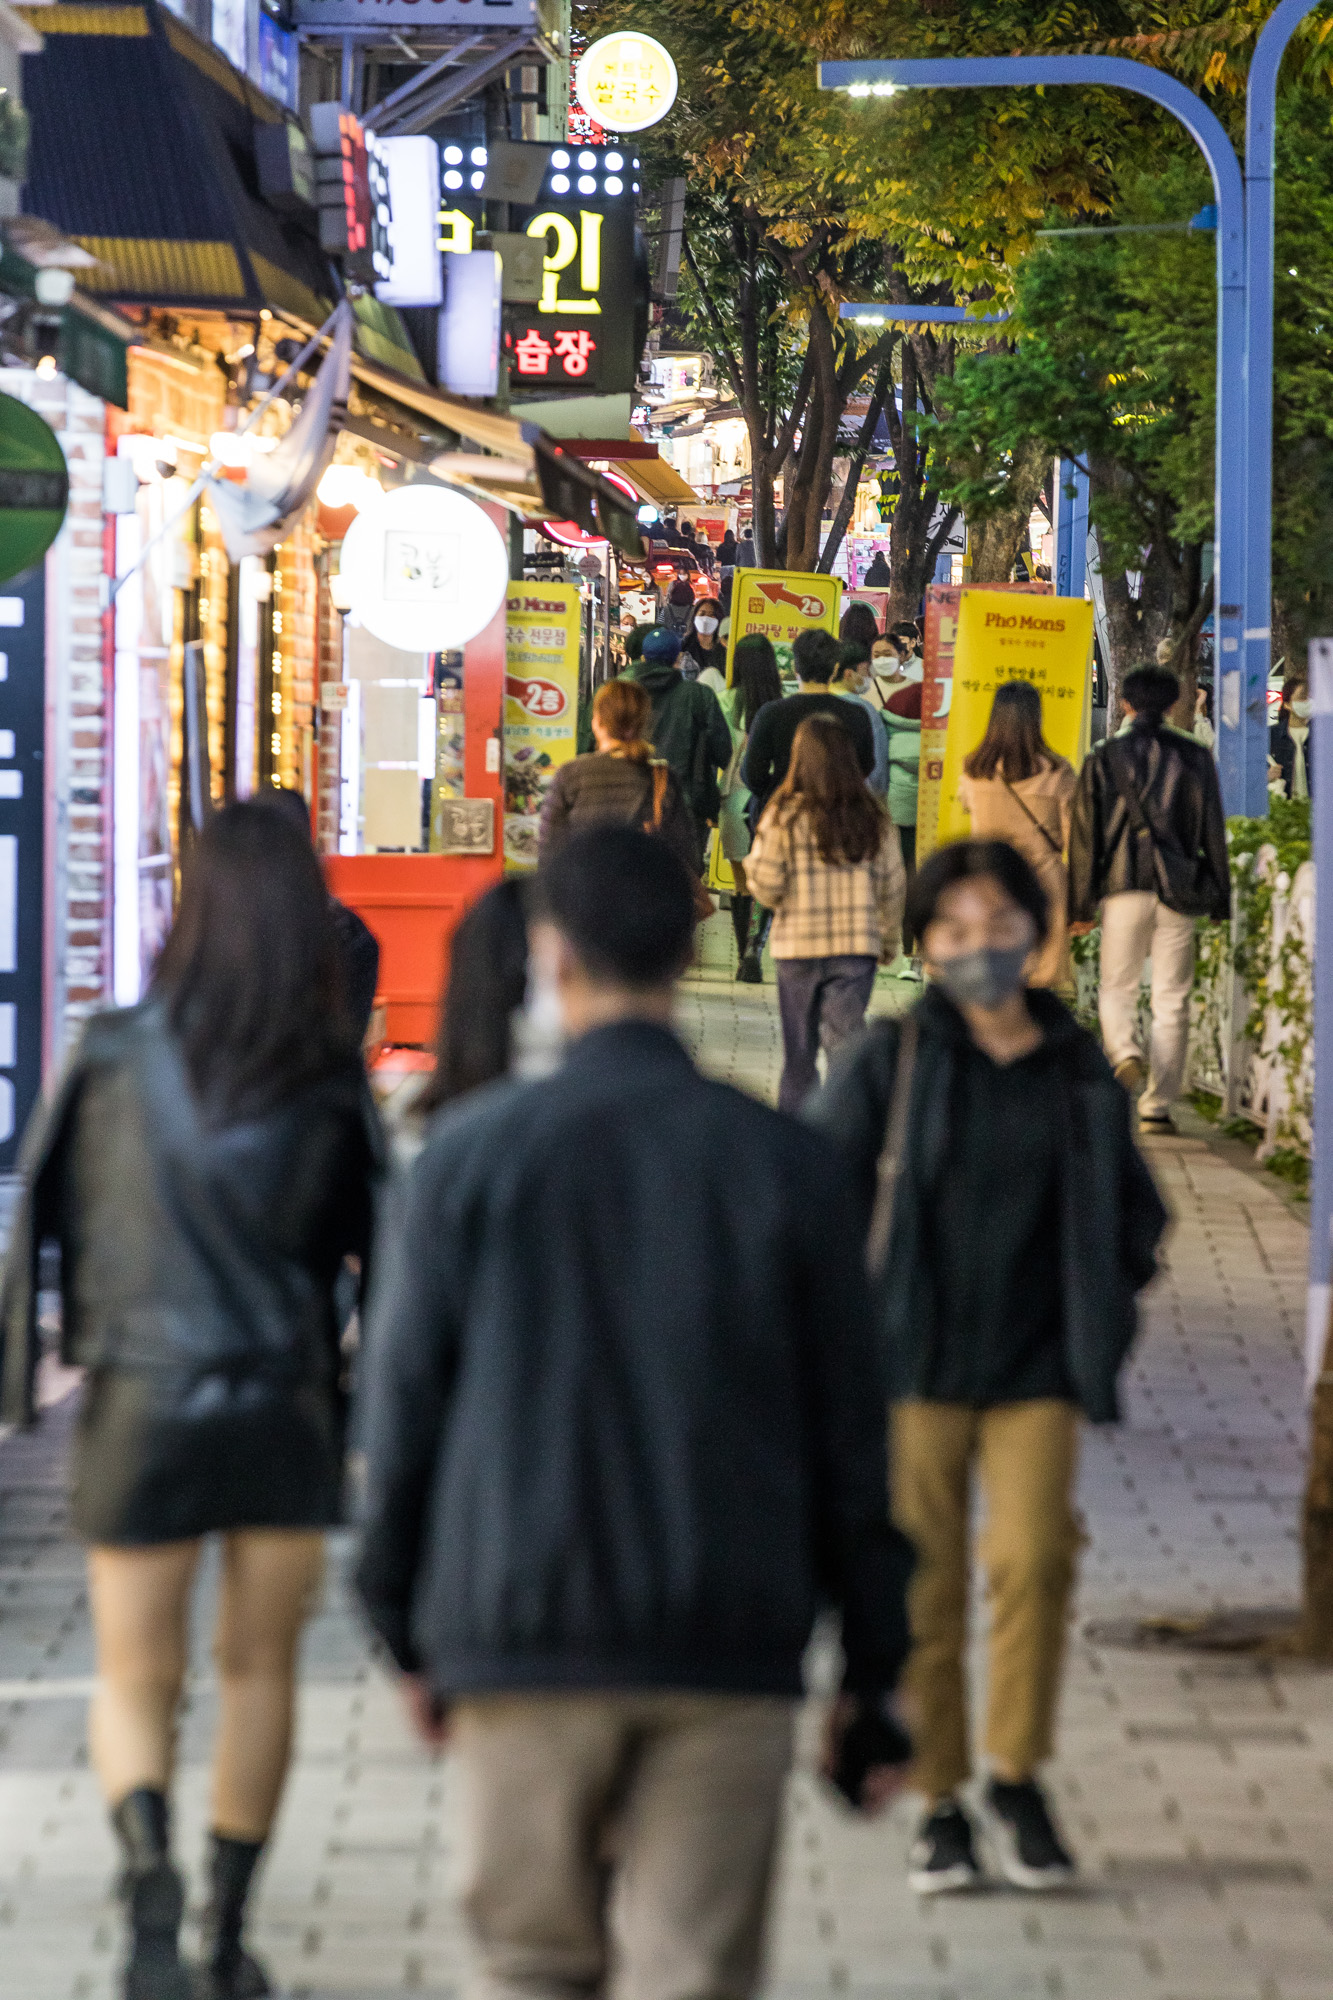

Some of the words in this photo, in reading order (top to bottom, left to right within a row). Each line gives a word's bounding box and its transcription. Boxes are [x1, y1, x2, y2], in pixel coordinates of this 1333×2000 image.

[596, 81, 661, 104] 쌀국수
[506, 328, 597, 377] 습장
[801, 597, 821, 614] 2층
[1019, 615, 1066, 632] Mons
[530, 628, 566, 646] 전문점
[527, 683, 560, 711] 2층
